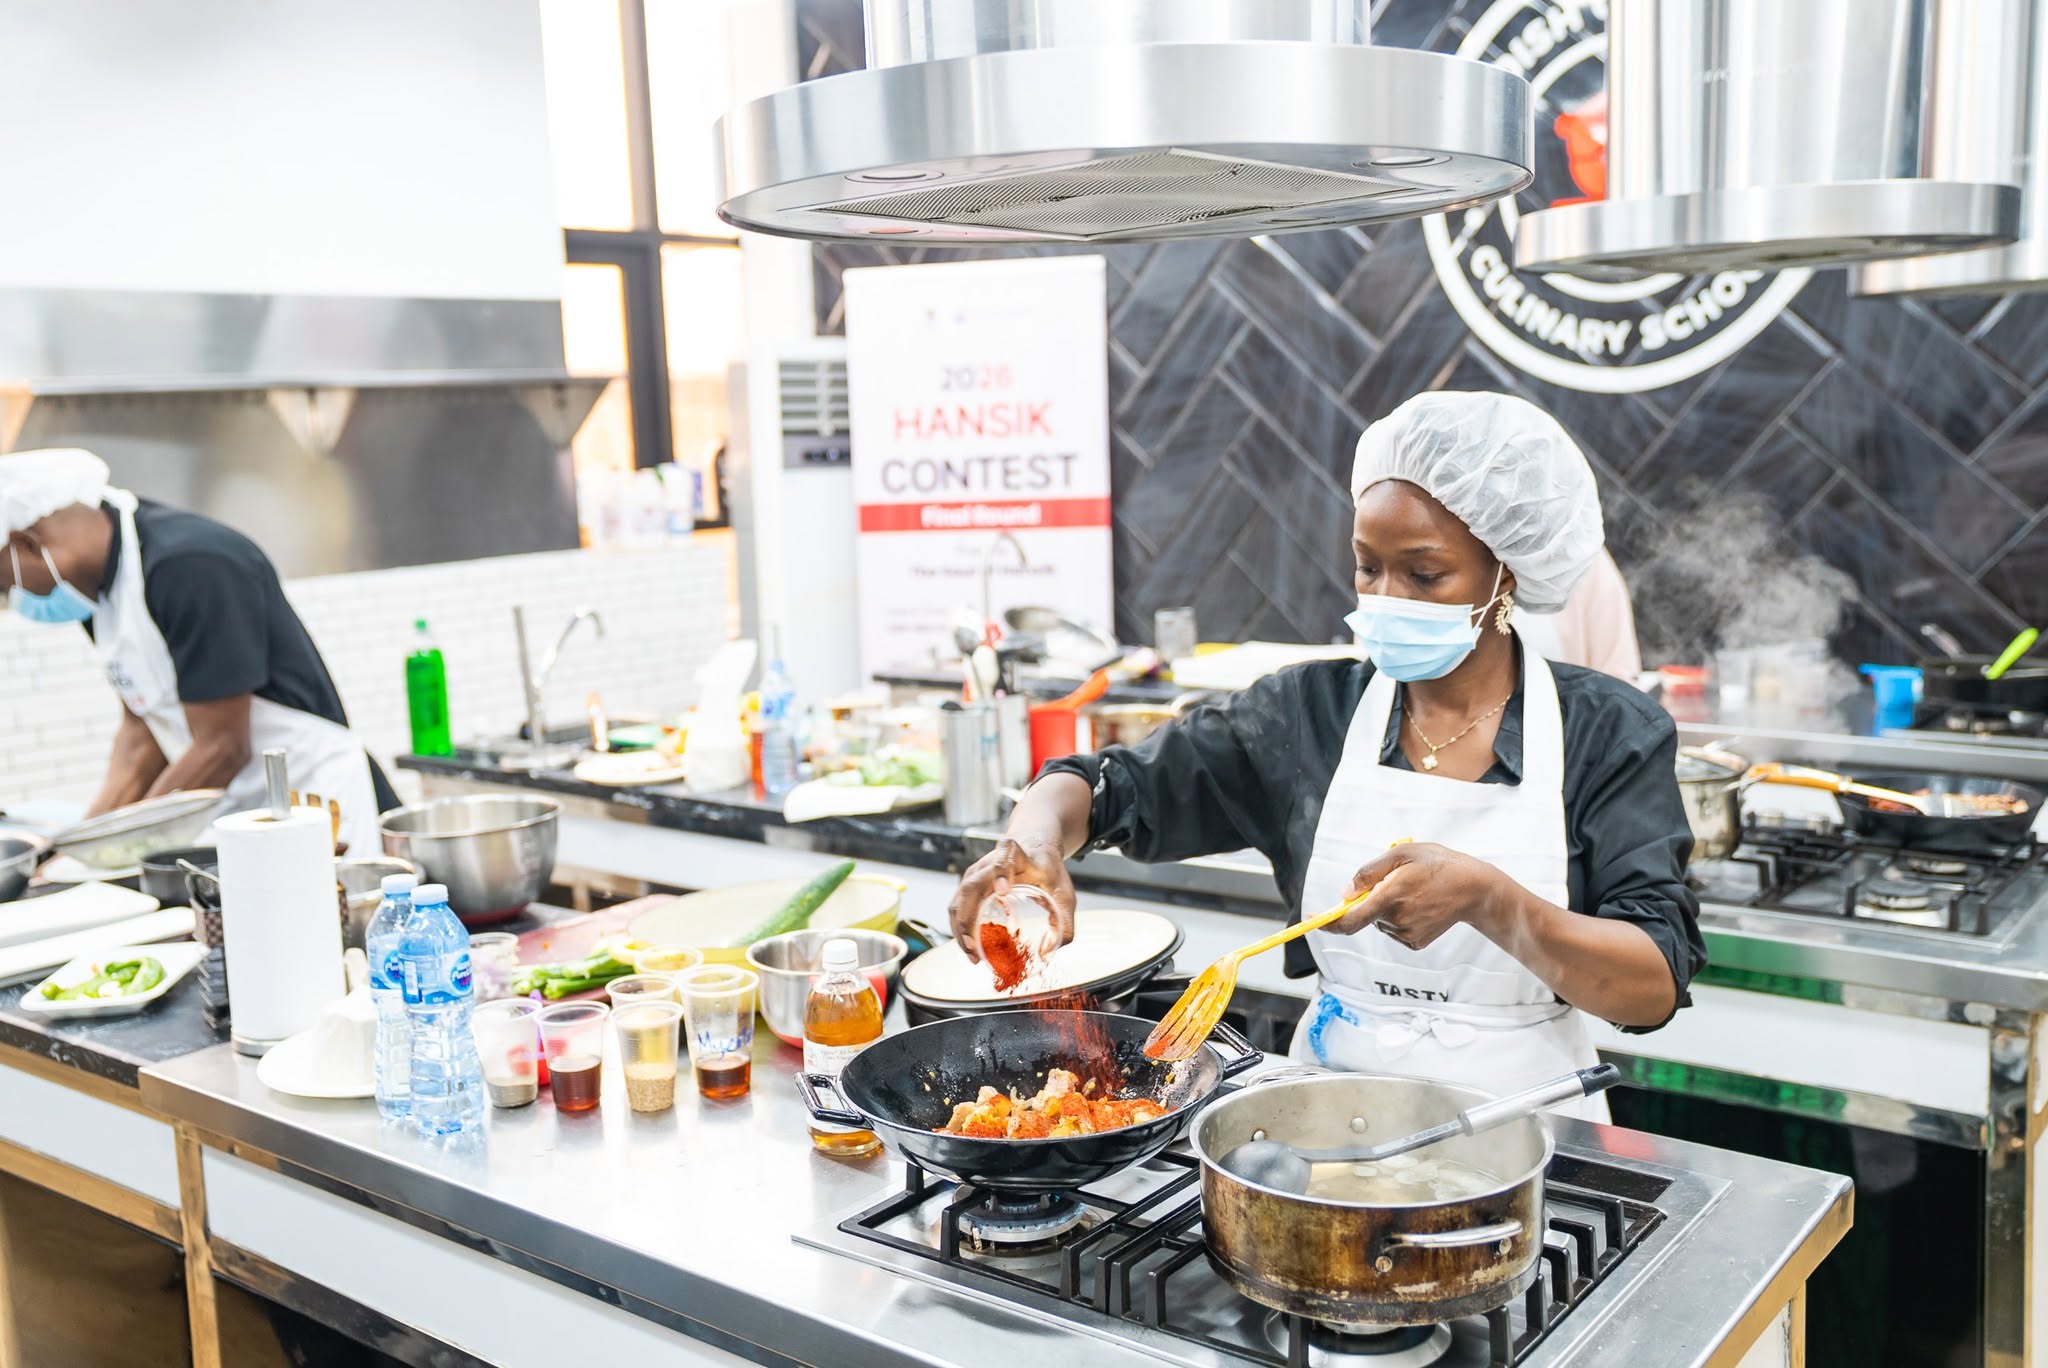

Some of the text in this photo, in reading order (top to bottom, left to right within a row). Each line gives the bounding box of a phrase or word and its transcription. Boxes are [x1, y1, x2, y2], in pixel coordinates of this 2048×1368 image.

[1470, 245, 1632, 356] CULINARY
[893, 402, 1053, 440] HANSIK
[880, 454, 1078, 494] CONTEST
[921, 503, 1042, 527] Final Round
[1374, 981, 1449, 1002] TASTY
